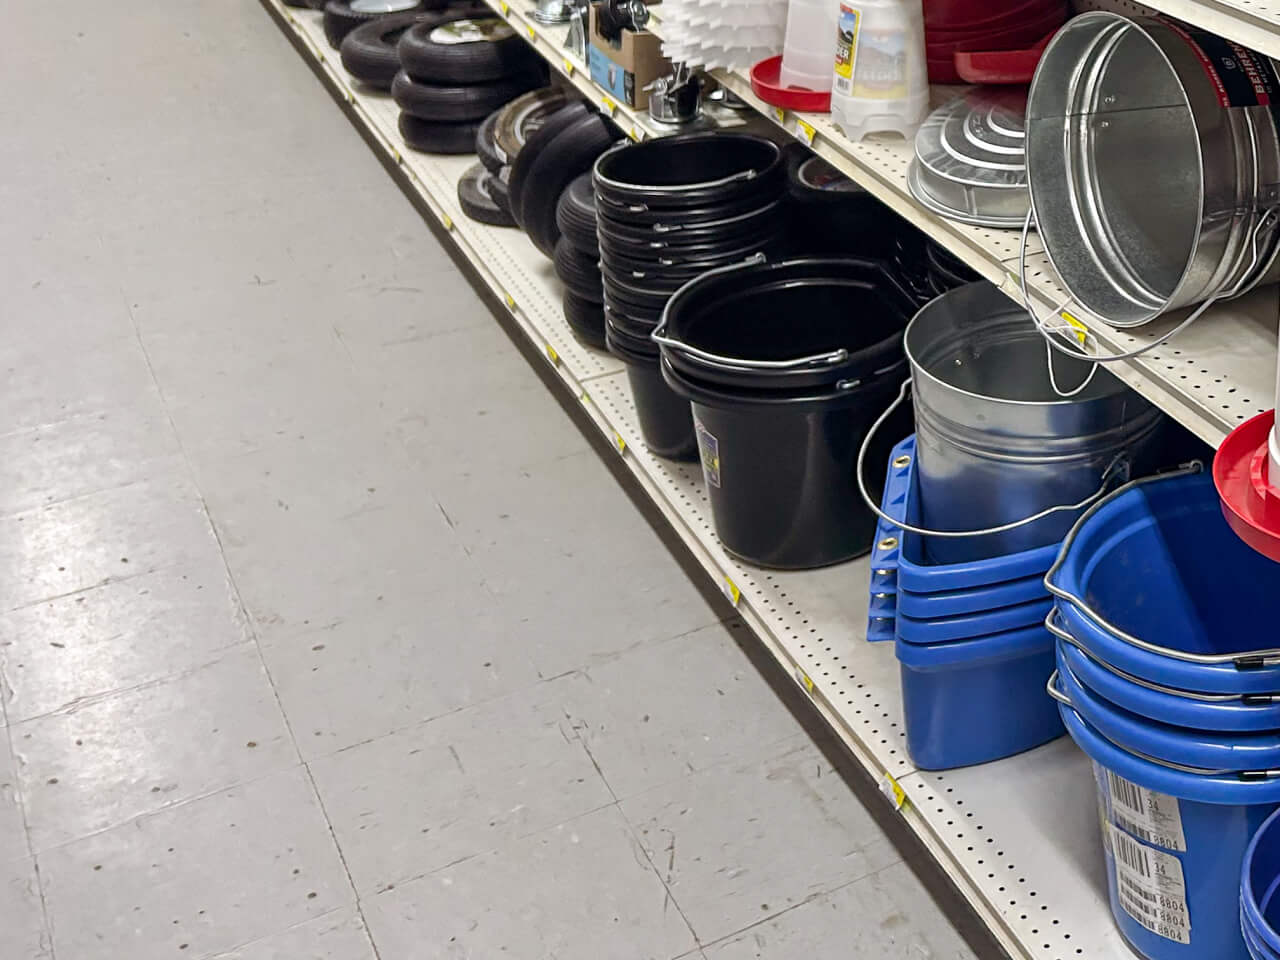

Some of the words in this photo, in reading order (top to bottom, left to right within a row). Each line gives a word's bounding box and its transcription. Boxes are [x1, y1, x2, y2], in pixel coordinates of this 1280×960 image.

[1154, 863, 1166, 874] 34
[1159, 895, 1184, 913] 8804
[1159, 911, 1185, 928] 8804
